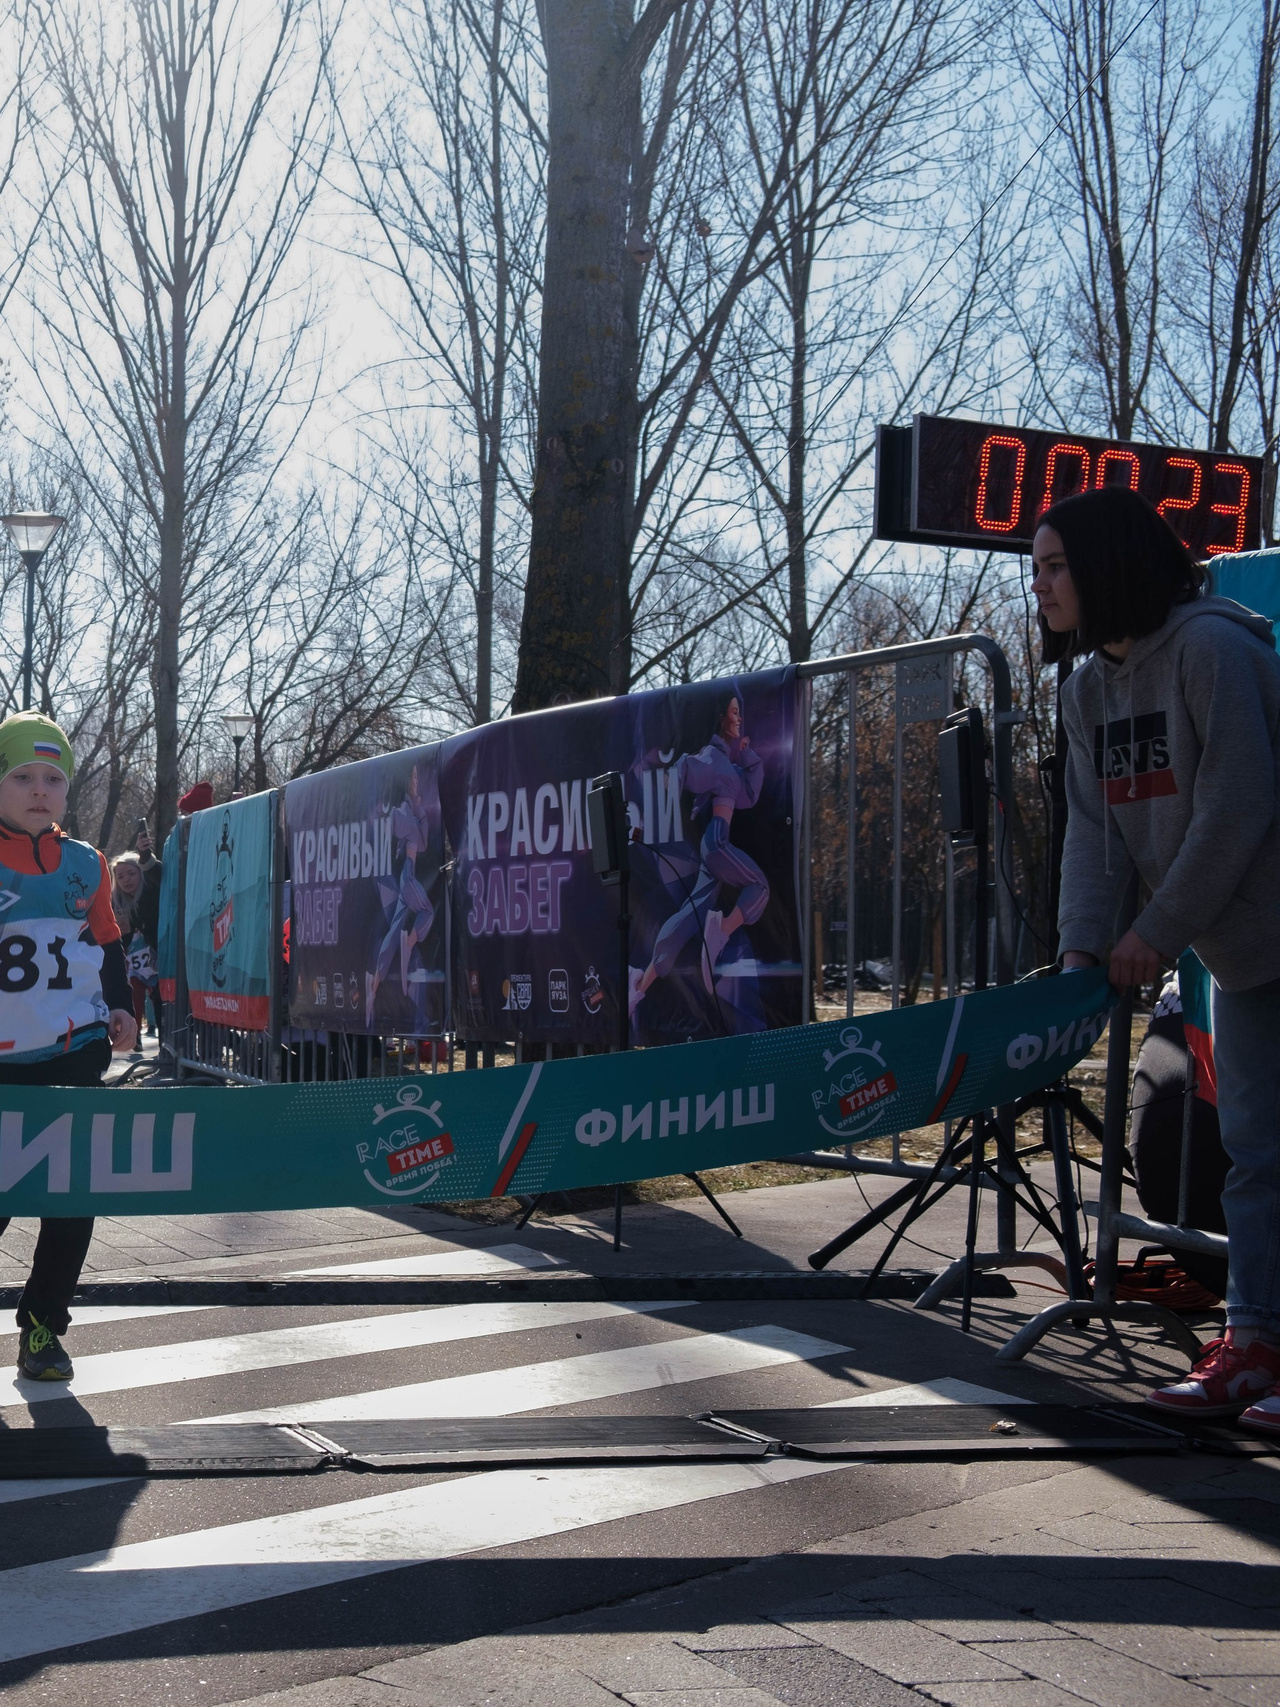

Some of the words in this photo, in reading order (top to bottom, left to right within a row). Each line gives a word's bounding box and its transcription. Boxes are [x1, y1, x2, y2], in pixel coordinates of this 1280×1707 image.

[467, 748, 684, 861] КРАСИЫЙ
[294, 802, 393, 884] КРАСИВЫЙ
[294, 886, 343, 946] ЗАБЕГ
[468, 862, 572, 936] ЗАБЕГ
[131, 953, 150, 970] 52
[550, 980, 567, 990] ПАРК
[551, 990, 568, 1000] ЯУЗА
[811, 1066, 867, 1110] RACE
[846, 1078, 889, 1110] TIME
[575, 1083, 775, 1147] ФИНИШ
[837, 1110, 866, 1129] ВРЕМЯ
[356, 1123, 420, 1163] RACE
[395, 1139, 444, 1169] TIME
[385, 1170, 418, 1187] ВРЕМЯ
